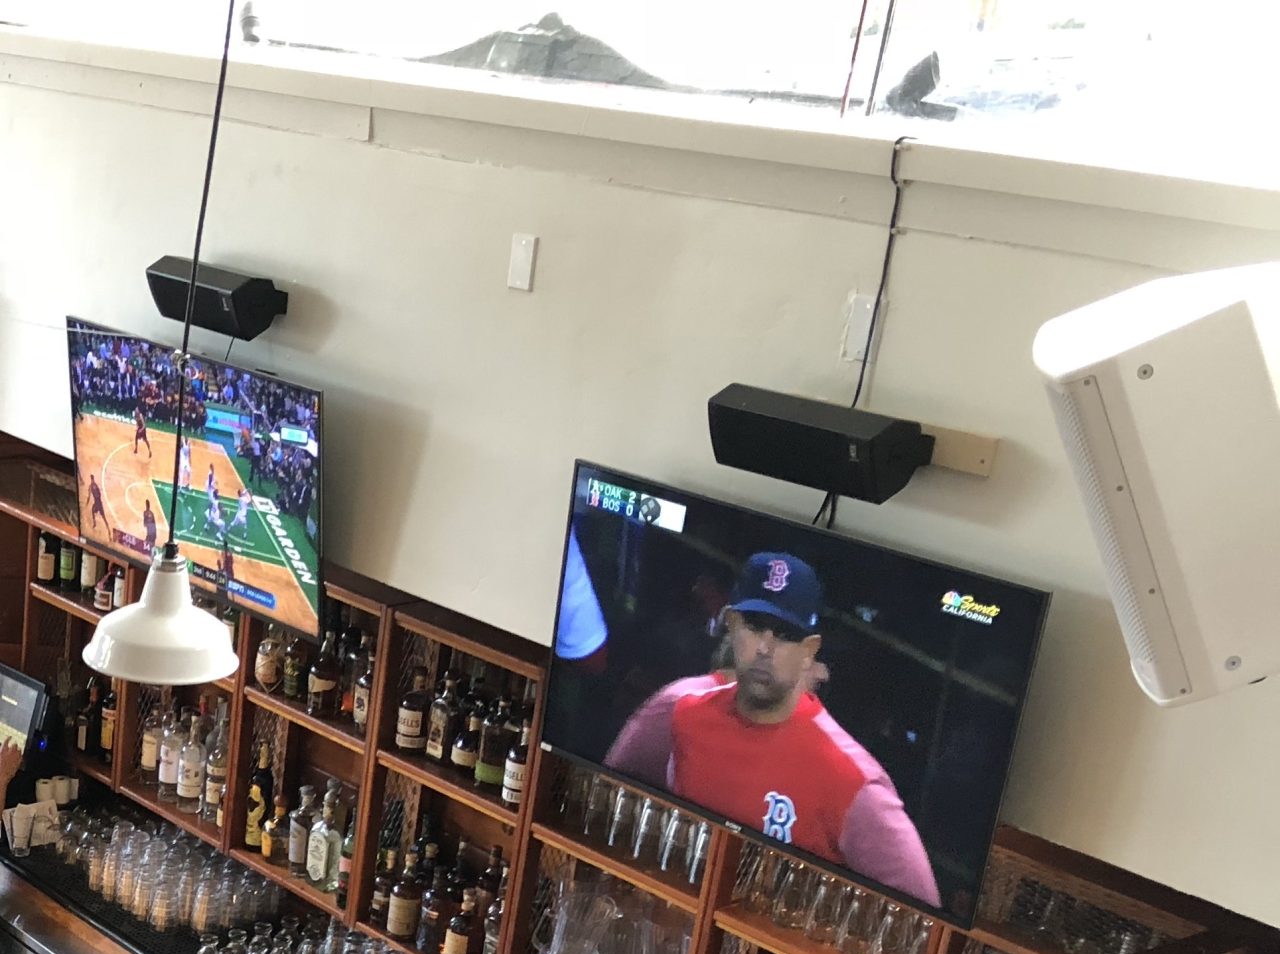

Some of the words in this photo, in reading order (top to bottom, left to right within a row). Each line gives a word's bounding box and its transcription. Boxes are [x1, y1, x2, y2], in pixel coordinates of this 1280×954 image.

[604, 485, 622, 499] OAK
[628, 491, 637, 503] 2
[602, 498, 621, 512] BOS
[625, 504, 634, 516] 0
[267, 507, 318, 585] GARDEN
[942, 604, 993, 625] CALIFORNIA
[960, 595, 1000, 617] Sports
